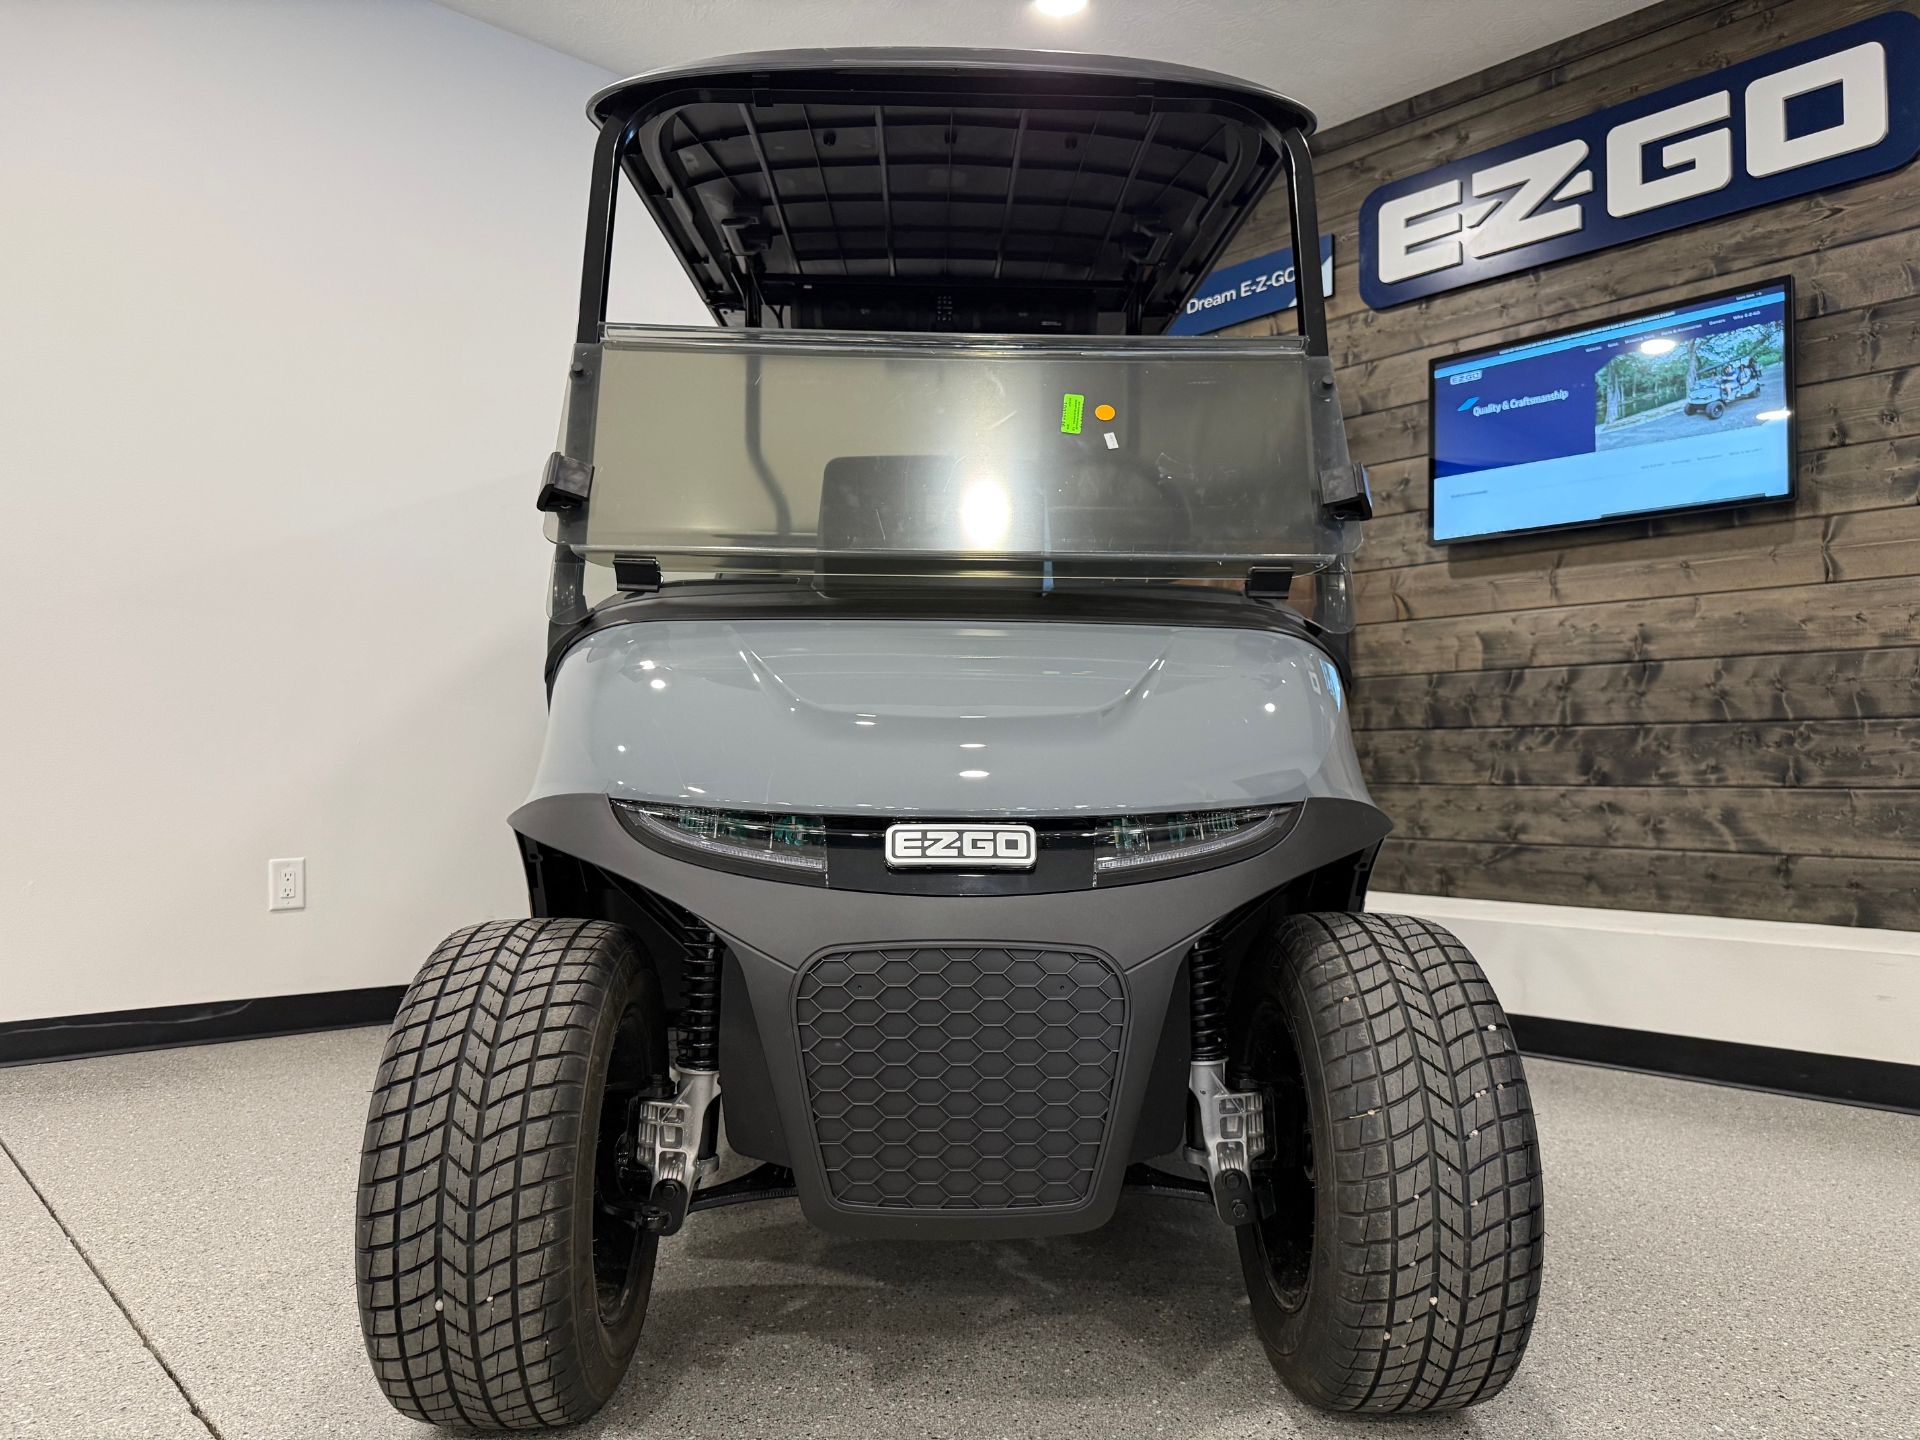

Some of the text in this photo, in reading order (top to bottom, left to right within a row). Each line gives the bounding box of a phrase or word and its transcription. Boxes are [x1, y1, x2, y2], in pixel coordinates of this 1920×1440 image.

[1186, 289, 1236, 314] Dream
[1473, 390, 1569, 416] Quality & Craftsmanship
